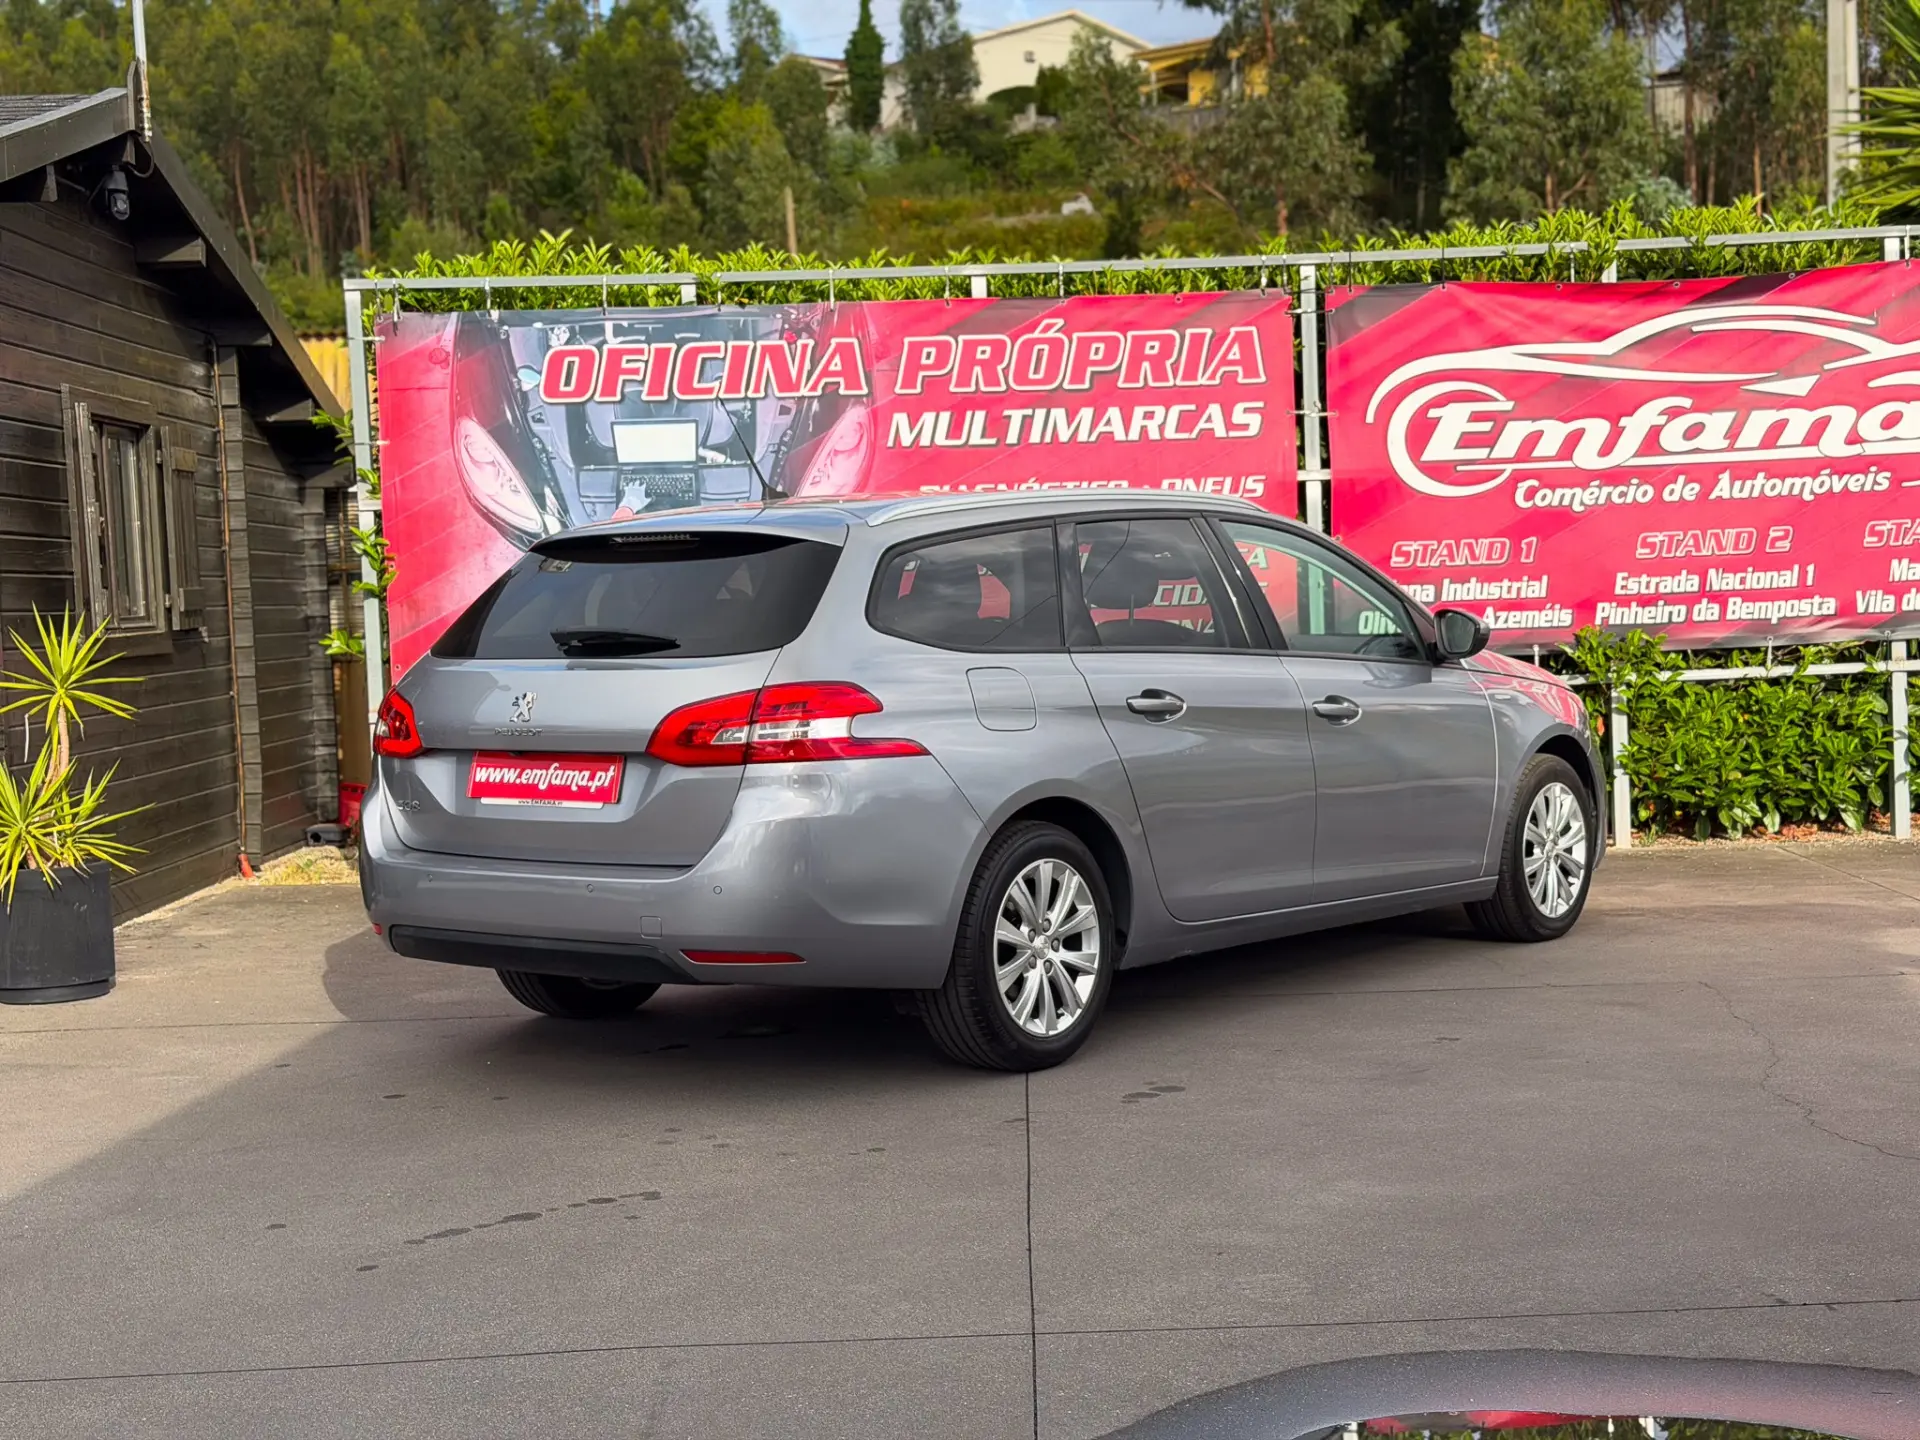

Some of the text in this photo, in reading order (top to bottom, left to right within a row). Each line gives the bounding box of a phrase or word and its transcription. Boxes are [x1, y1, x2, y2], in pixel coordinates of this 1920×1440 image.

[539, 319, 1266, 403] OFICINA PRÓPRIA
[886, 402, 1264, 449] MULTIMARCAS
[1419, 396, 1920, 470] Emfama
[1514, 465, 1891, 512] Comércio de Automóveis
[1390, 537, 1538, 567] STAND 1
[1635, 526, 1794, 559] STAND 2
[1441, 575, 1548, 601] Industrial
[1615, 563, 1815, 595] Estrada Nacional 1
[1483, 603, 1573, 629] Azeméis
[1595, 596, 1837, 627] Pinheiro da Bemposta
[1856, 589, 1896, 613] Vila
[474, 763, 615, 792] www.emfama.pt
